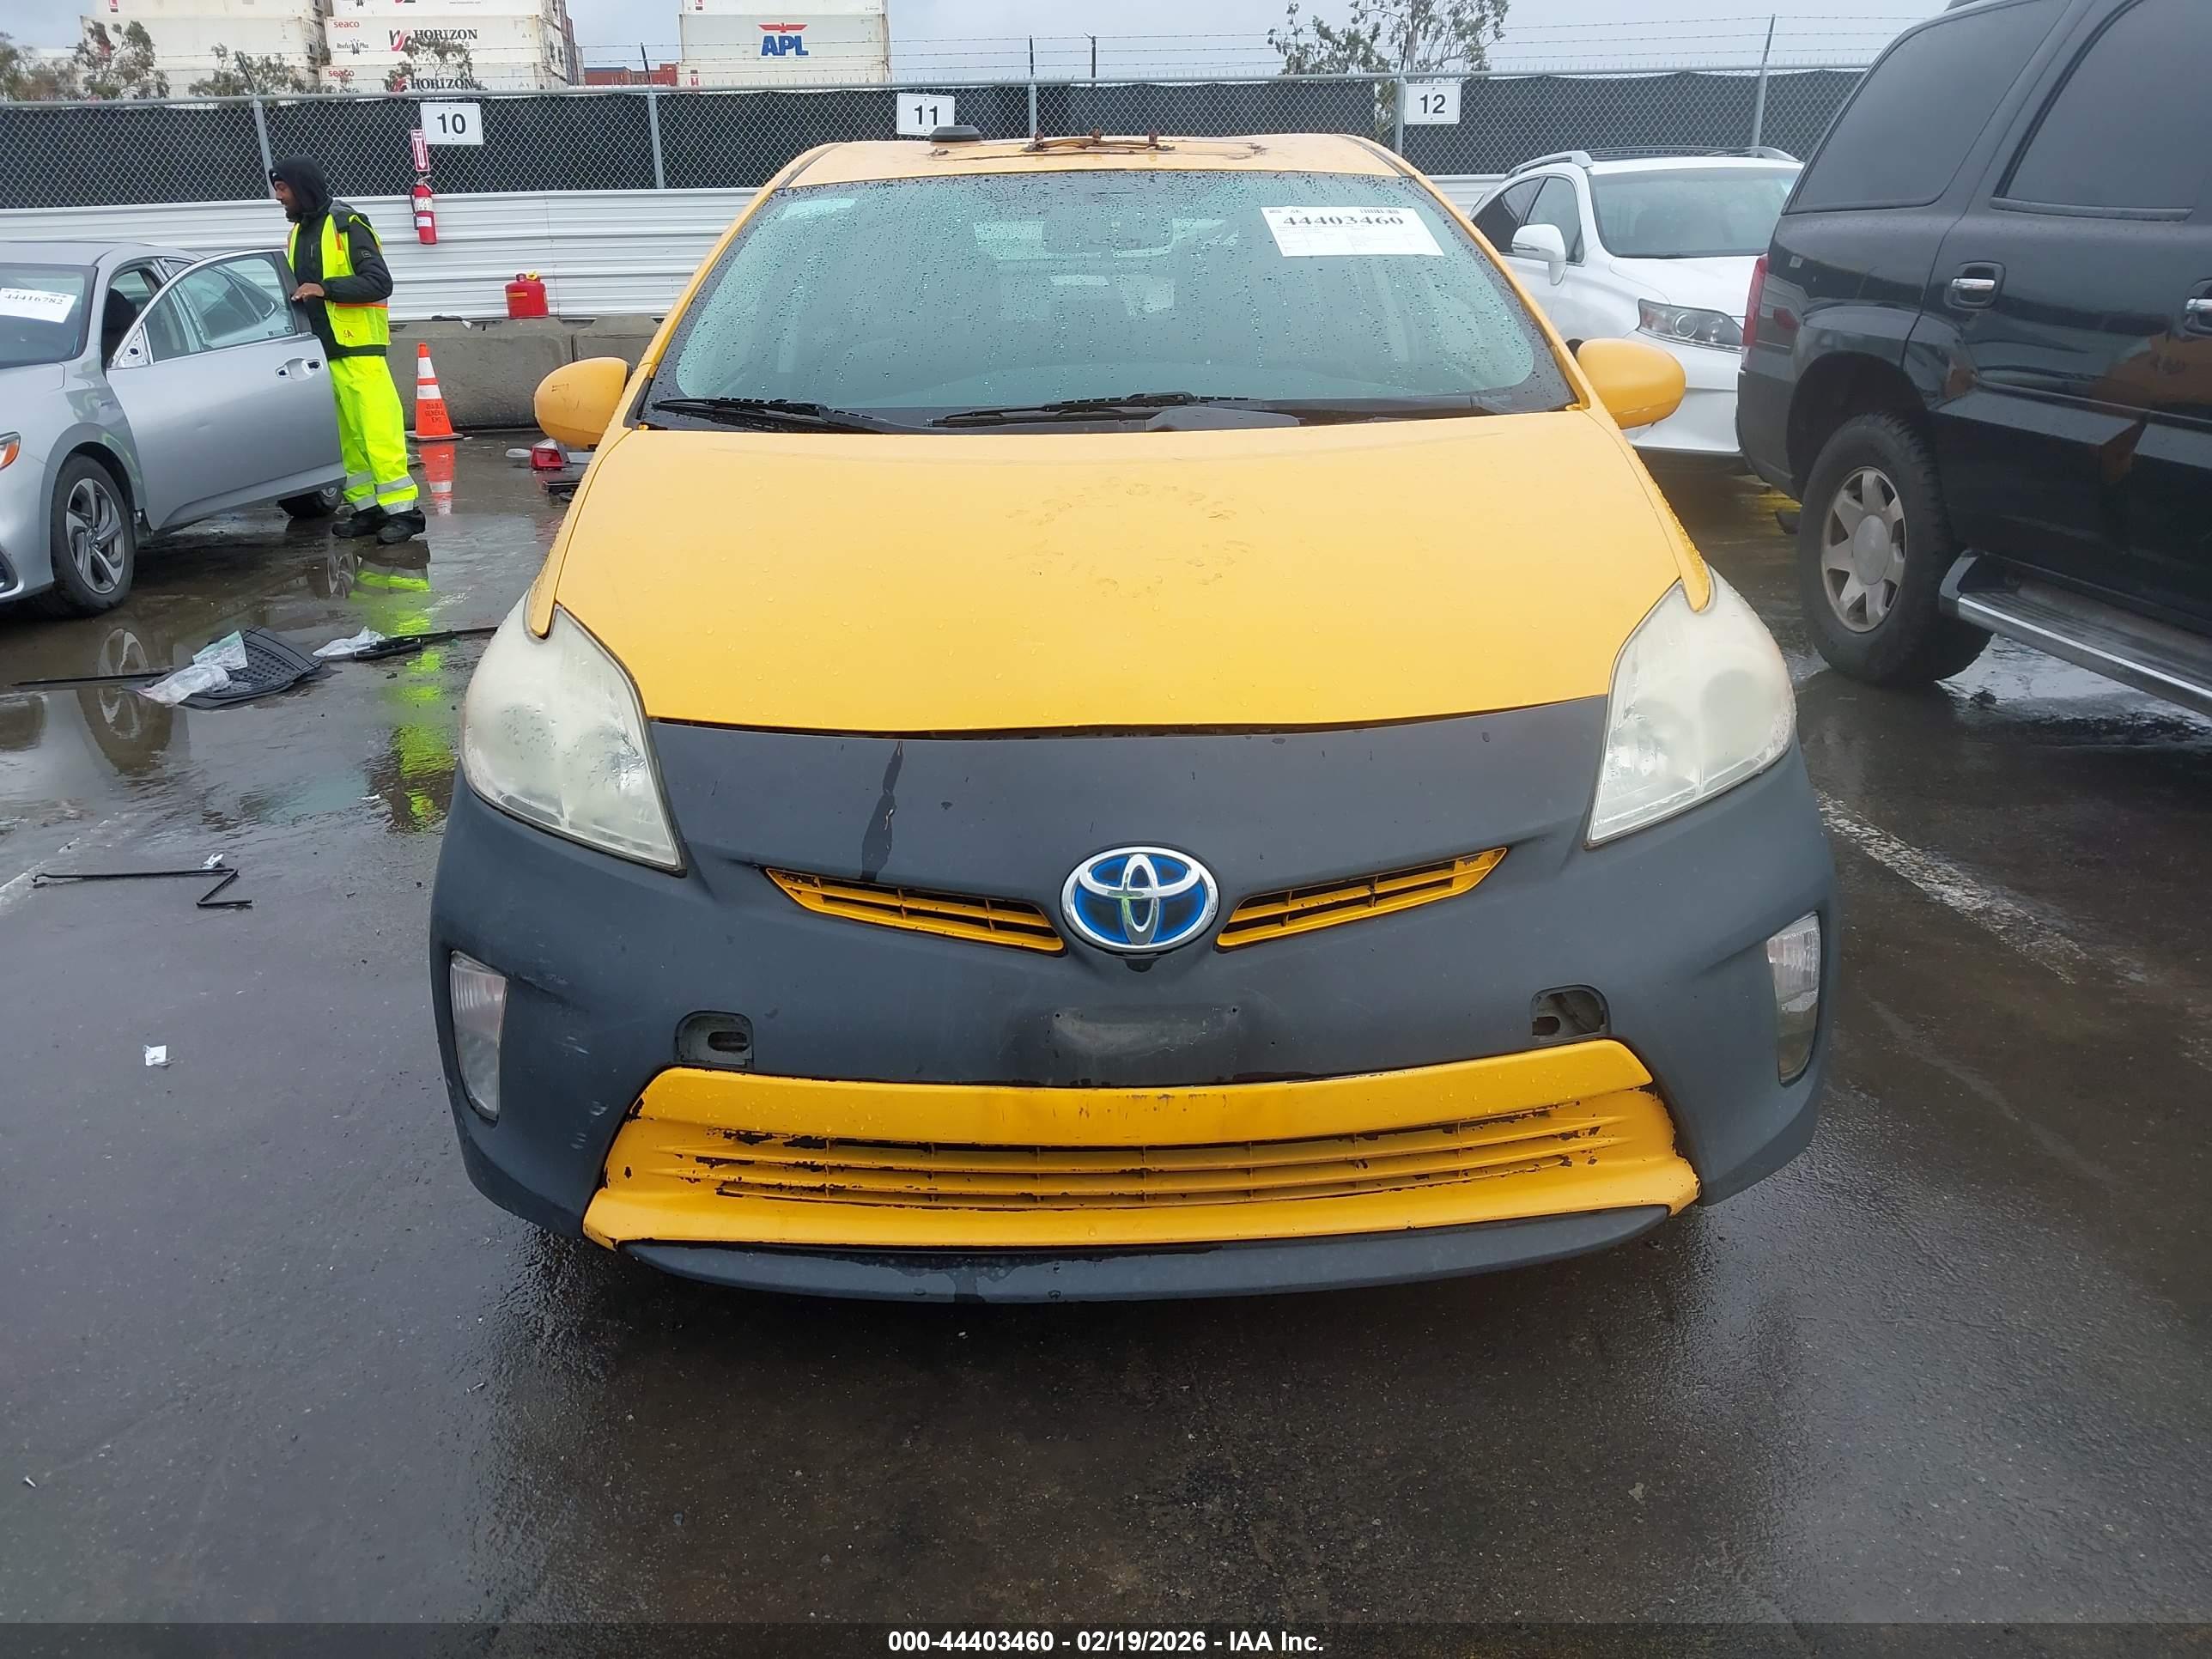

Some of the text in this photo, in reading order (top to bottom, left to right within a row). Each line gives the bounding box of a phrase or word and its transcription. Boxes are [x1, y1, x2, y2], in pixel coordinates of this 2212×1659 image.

[413, 29, 478, 40] HORIZON
[761, 35, 809, 56] APL
[328, 69, 355, 77] seaco
[411, 77, 474, 89] HORIZON
[1419, 94, 1446, 114] 12
[914, 104, 938, 126] 11
[436, 112, 466, 135] 10
[1283, 216, 1404, 226] 44403460
[3, 294, 63, 304] 44416782
